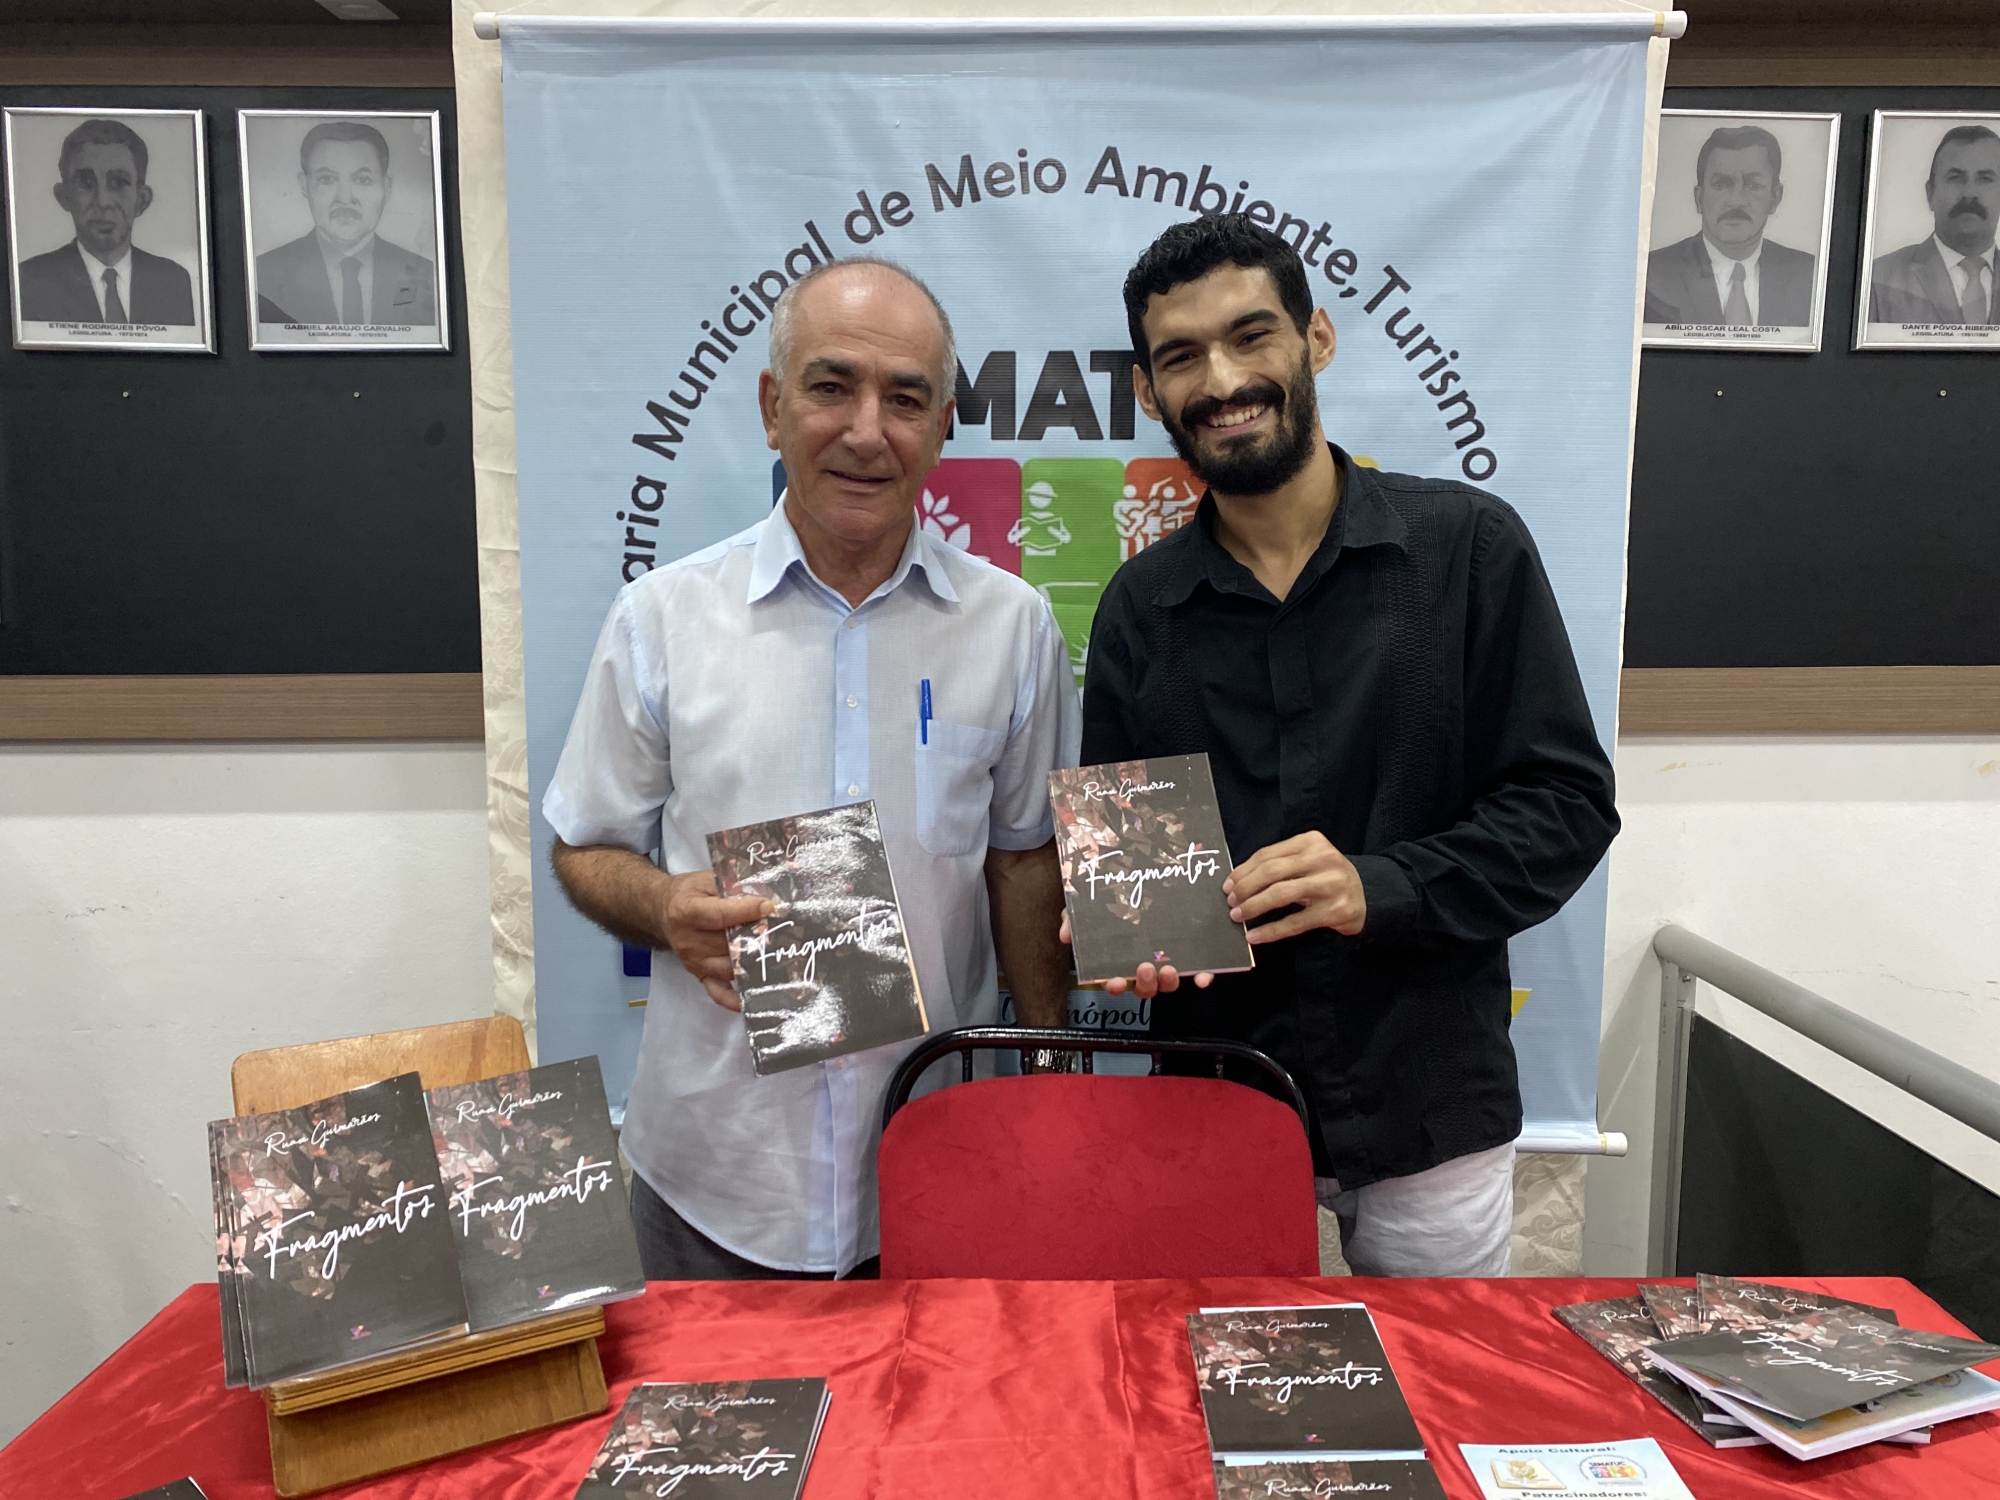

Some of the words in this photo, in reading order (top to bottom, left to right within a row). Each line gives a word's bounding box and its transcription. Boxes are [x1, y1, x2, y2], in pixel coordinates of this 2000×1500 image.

[82, 323, 134, 331] RODRIGUES
[136, 324, 167, 332] PÓVOA
[632, 219, 836, 461] Municipal
[844, 189, 914, 244] de
[924, 148, 1067, 212] Meio
[1085, 145, 1358, 298] Ambiente,
[1363, 265, 1498, 482] Turismo
[1665, 323, 1693, 331] ABÍLIO
[1933, 323, 1963, 331] PÓVOA
[1080, 841, 1220, 908] Fragmentos
[750, 901, 894, 983] Fragmentos
[453, 1155, 612, 1241] Fragmentos
[260, 1180, 435, 1279] Fragmentos
[1219, 1361, 1383, 1403] Fragmentos
[611, 1446, 796, 1497] Fragmentos
[1548, 1446, 1617, 1454] Cultural:
